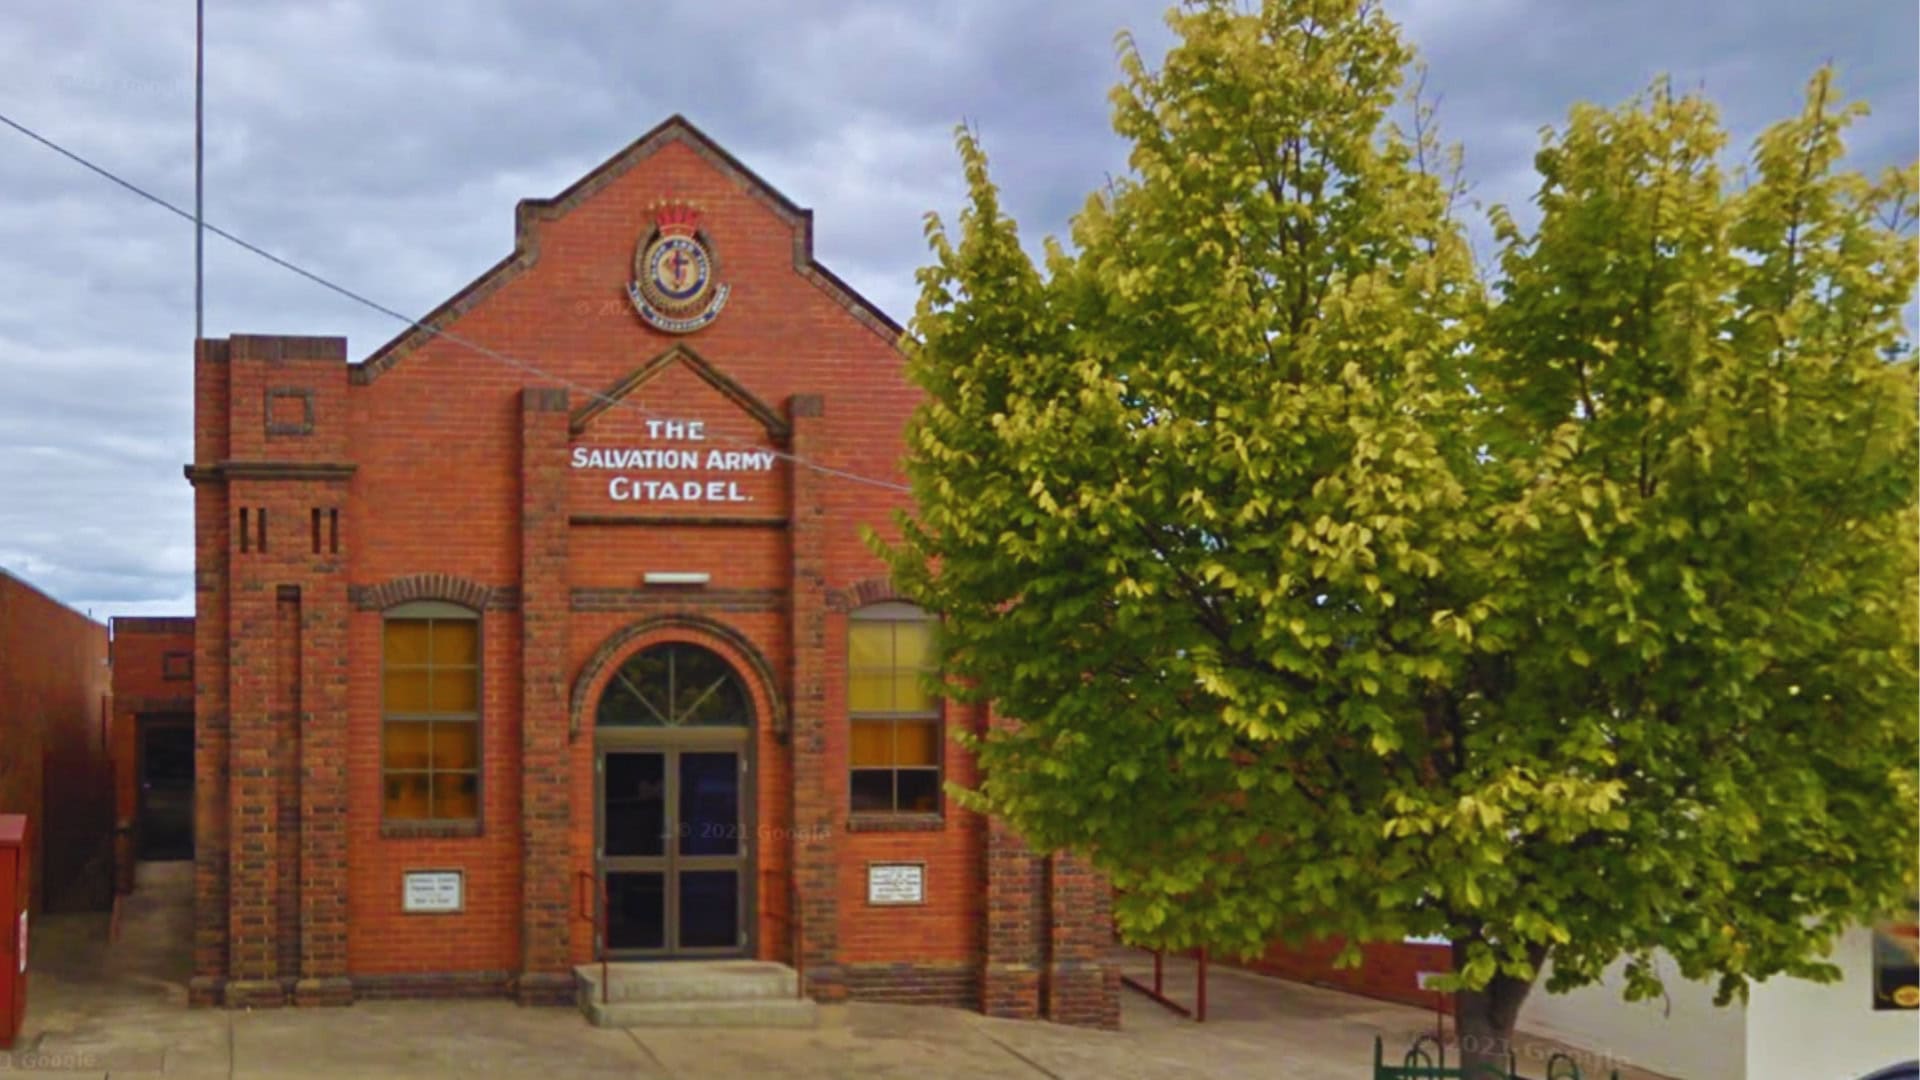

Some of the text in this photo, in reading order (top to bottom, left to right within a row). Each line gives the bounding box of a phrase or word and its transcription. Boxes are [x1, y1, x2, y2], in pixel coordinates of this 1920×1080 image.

[646, 420, 705, 440] THE
[571, 448, 775, 470] SALVATION ARMY
[609, 477, 754, 501] CITADEL.
